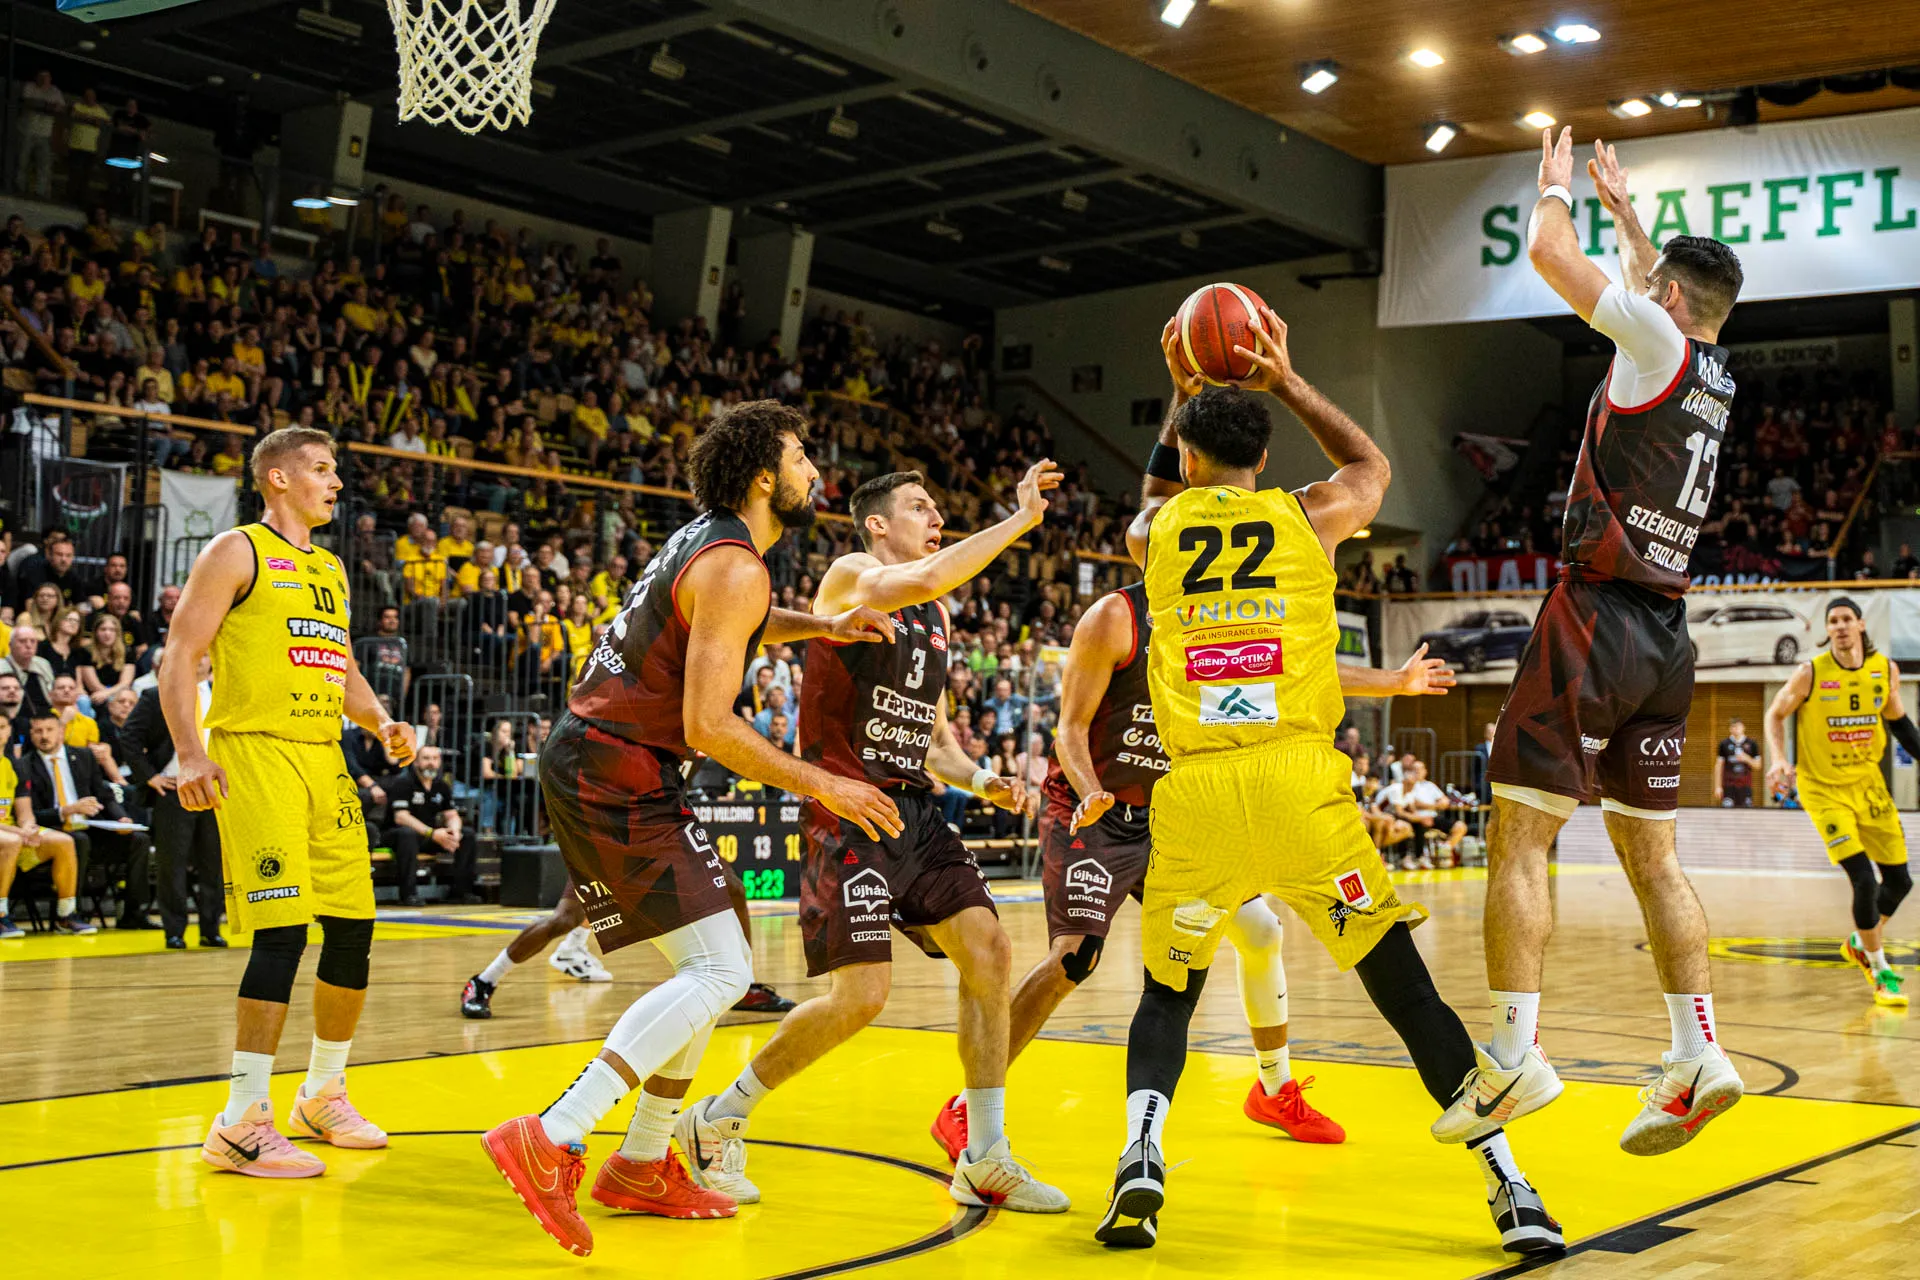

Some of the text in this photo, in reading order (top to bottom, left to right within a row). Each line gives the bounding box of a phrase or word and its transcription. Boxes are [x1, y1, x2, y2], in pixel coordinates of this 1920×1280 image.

[1481, 167, 1918, 268] SHAEFFL
[1675, 431, 1720, 519] 13
[1626, 503, 1699, 550] SZÉKELY PÉ
[1178, 520, 1277, 597] 22
[308, 583, 336, 615] 10
[1176, 598, 1287, 628] UNION
[1208, 627, 1257, 641] INSURANCE
[905, 647, 927, 690] 3
[1192, 652, 1273, 669] TREND OPTIKA
[290, 708, 322, 718] ALPOK
[1850, 693, 1860, 711] 6
[863, 747, 922, 771] STADL
[758, 806, 767, 825] 1
[717, 834, 738, 863] 10
[753, 835, 771, 860] 13
[743, 868, 785, 899] 5:23
